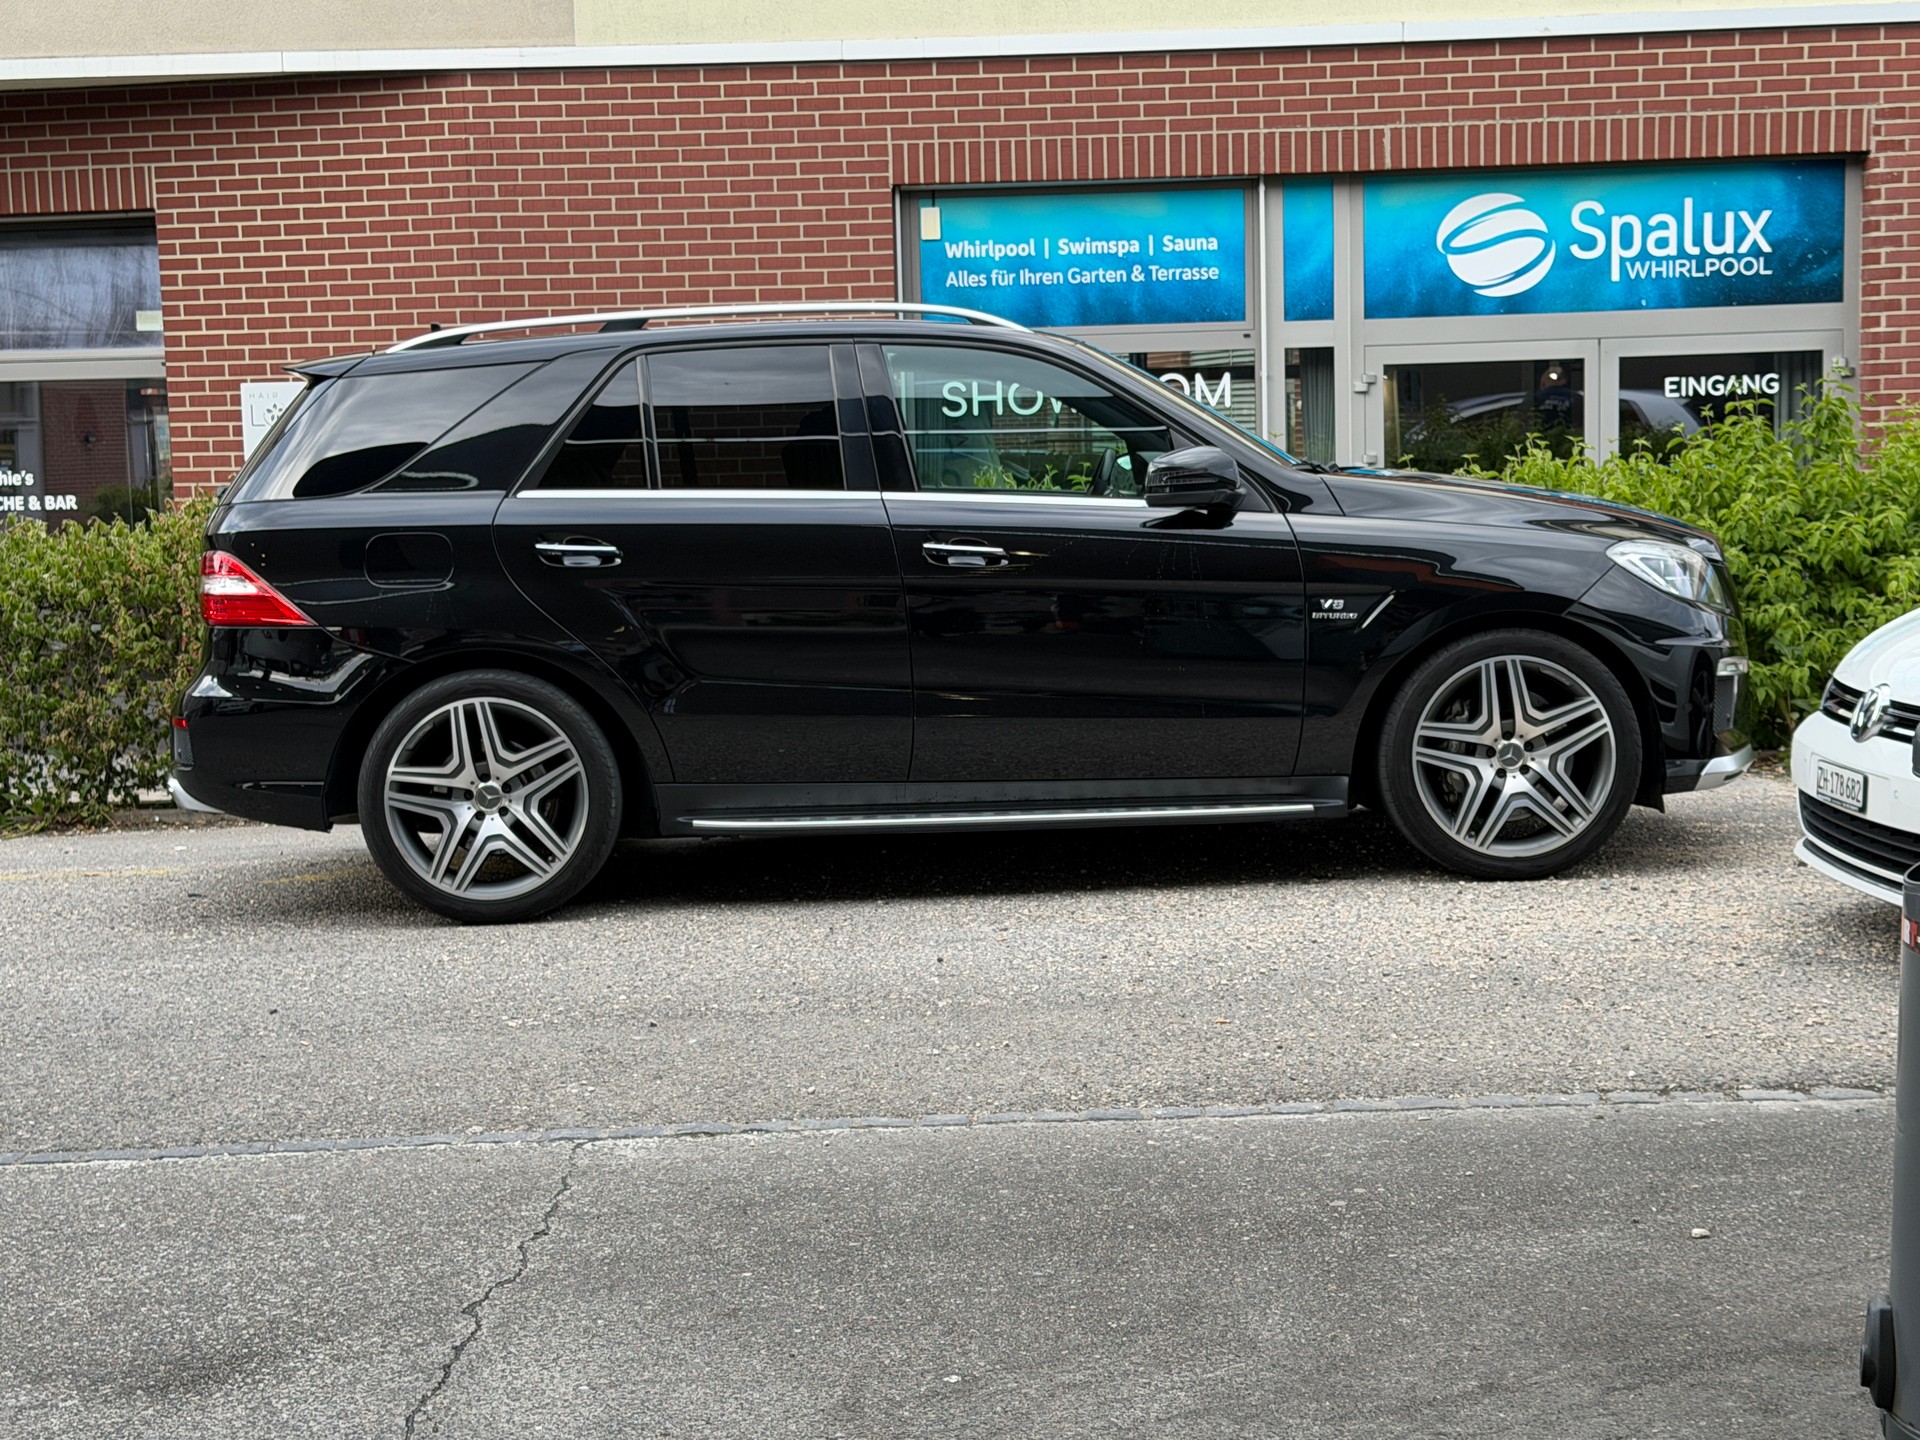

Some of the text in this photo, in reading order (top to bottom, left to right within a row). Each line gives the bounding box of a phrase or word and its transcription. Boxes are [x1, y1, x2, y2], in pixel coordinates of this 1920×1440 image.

[944, 238, 1036, 261] Whirlpool
[1057, 237, 1140, 257] Swimspa
[1162, 234, 1218, 252] Sauna
[1569, 197, 1773, 282] Spalux
[945, 264, 1219, 288] Alles für Ihren Garten & Terrasse
[1625, 256, 1773, 280] WHIRLPOOL
[249, 391, 278, 399] HAIR
[1664, 373, 1780, 398] EINGANG
[28, 495, 41, 511] &
[44, 494, 78, 511] BAR
